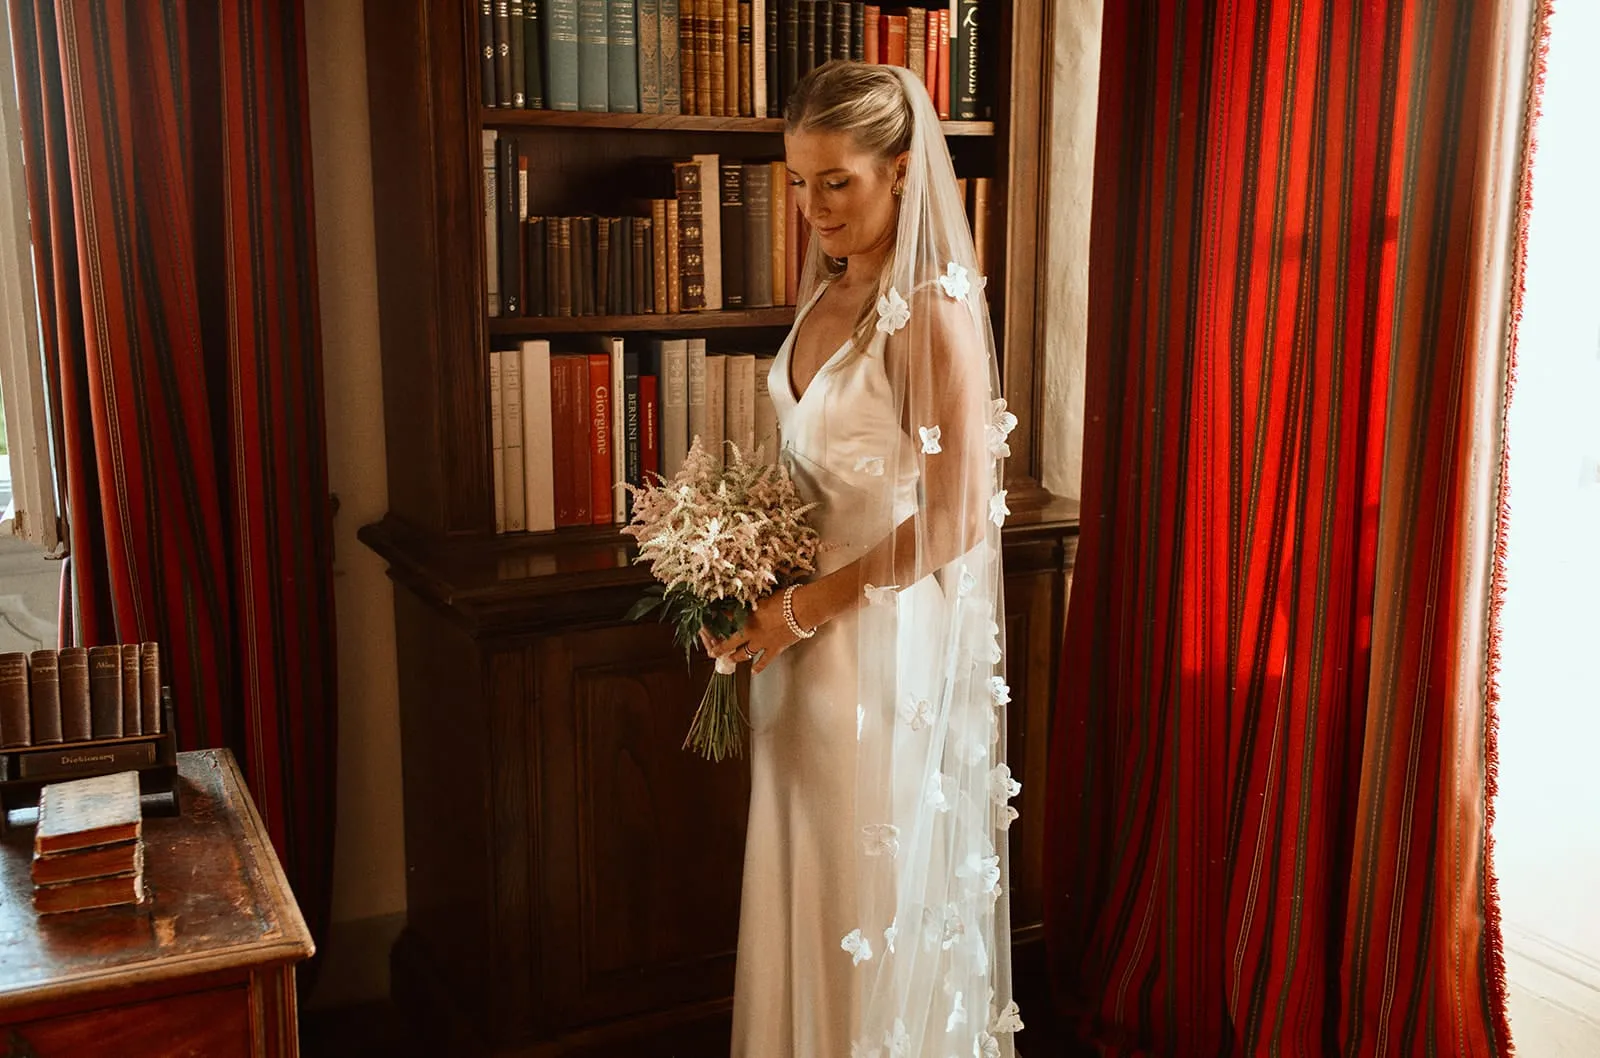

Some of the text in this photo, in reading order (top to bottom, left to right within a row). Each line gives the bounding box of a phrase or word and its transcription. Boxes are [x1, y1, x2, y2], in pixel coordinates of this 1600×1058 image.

[594, 386, 608, 455] Giorgione
[628, 393, 637, 440] BERNINI
[61, 754, 115, 764] Dictionary
